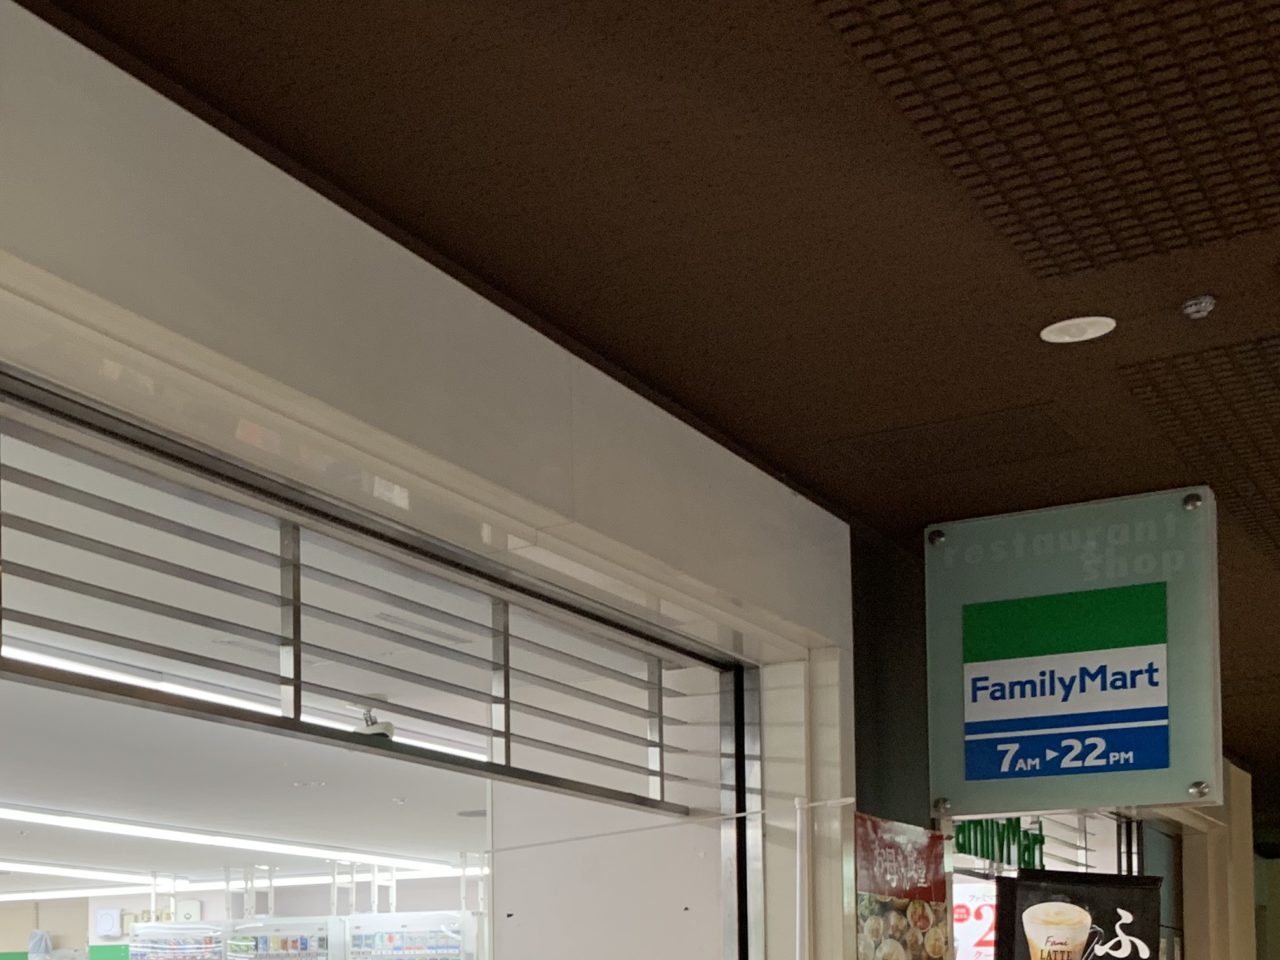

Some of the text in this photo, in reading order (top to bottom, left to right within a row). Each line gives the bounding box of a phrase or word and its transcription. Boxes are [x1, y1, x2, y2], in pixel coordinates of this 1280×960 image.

[971, 662, 1159, 703] FamilyMart
[955, 816, 1045, 871] amilyMart
[1040, 949, 1073, 960] LATTE
